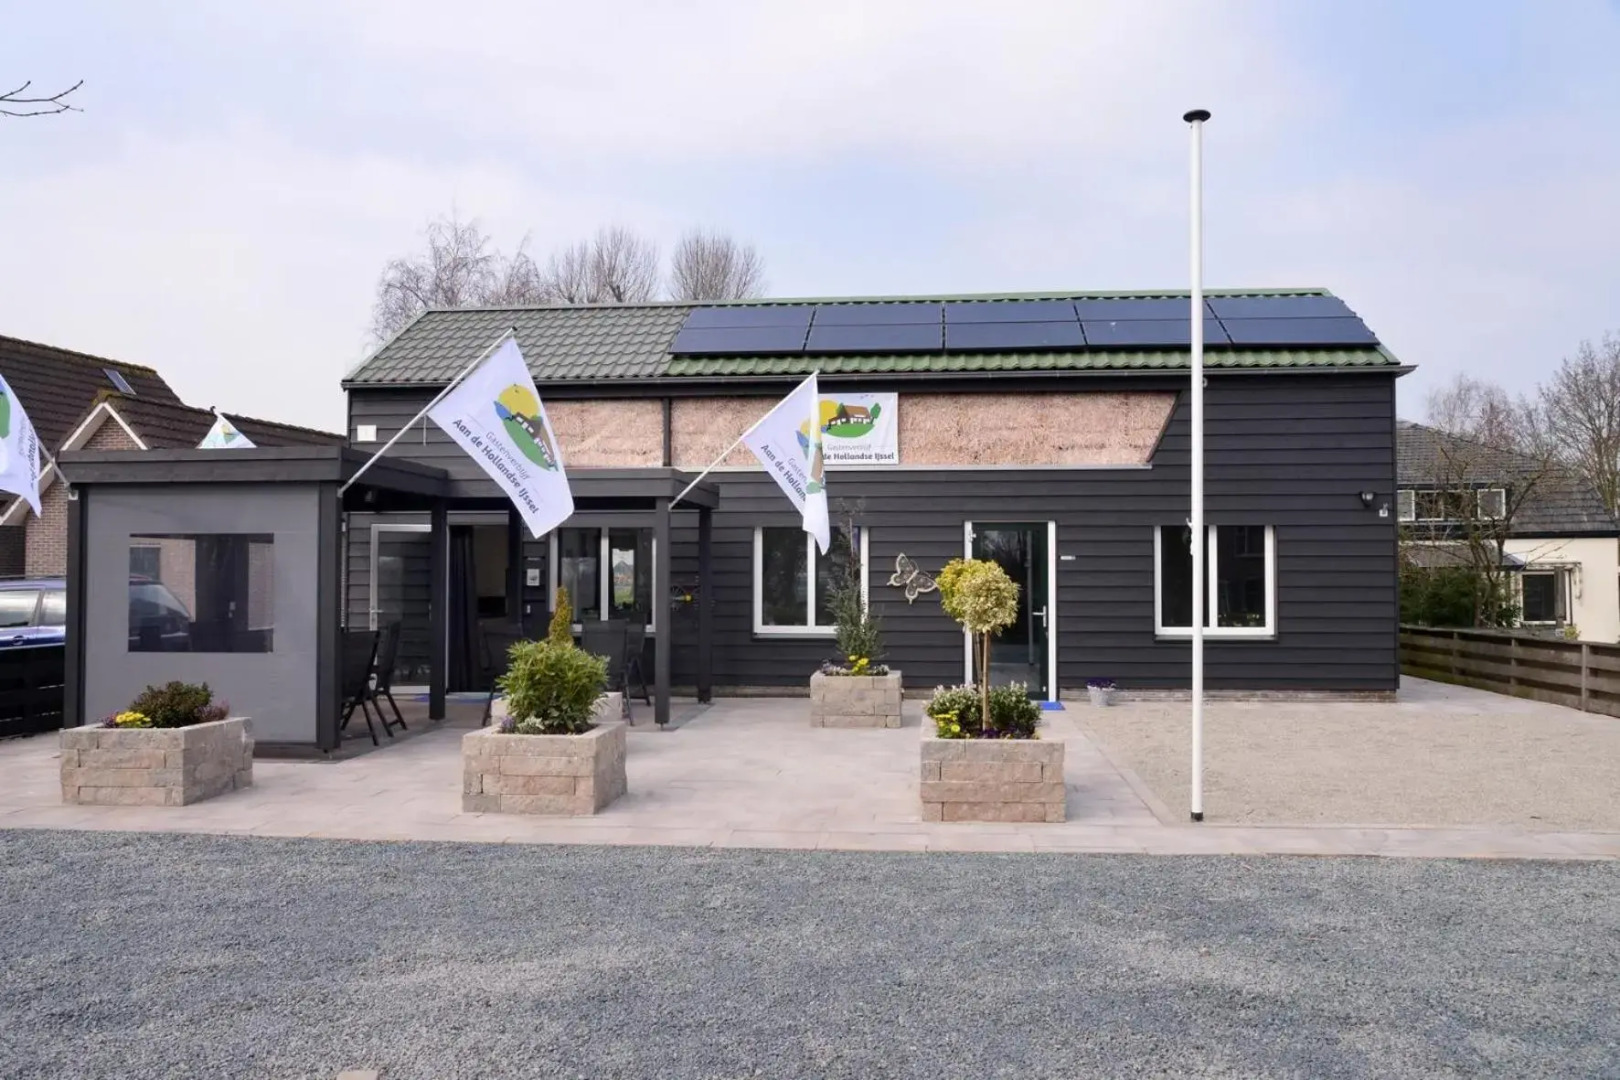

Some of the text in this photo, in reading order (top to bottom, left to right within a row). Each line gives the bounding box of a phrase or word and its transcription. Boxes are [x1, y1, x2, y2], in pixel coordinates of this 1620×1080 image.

[453, 419, 472, 438] Aan
[470, 433, 483, 448] de
[481, 444, 521, 488] Hollandse
[760, 444, 776, 462] Aan
[774, 460, 785, 473] de
[833, 452, 873, 460] Hollandse
